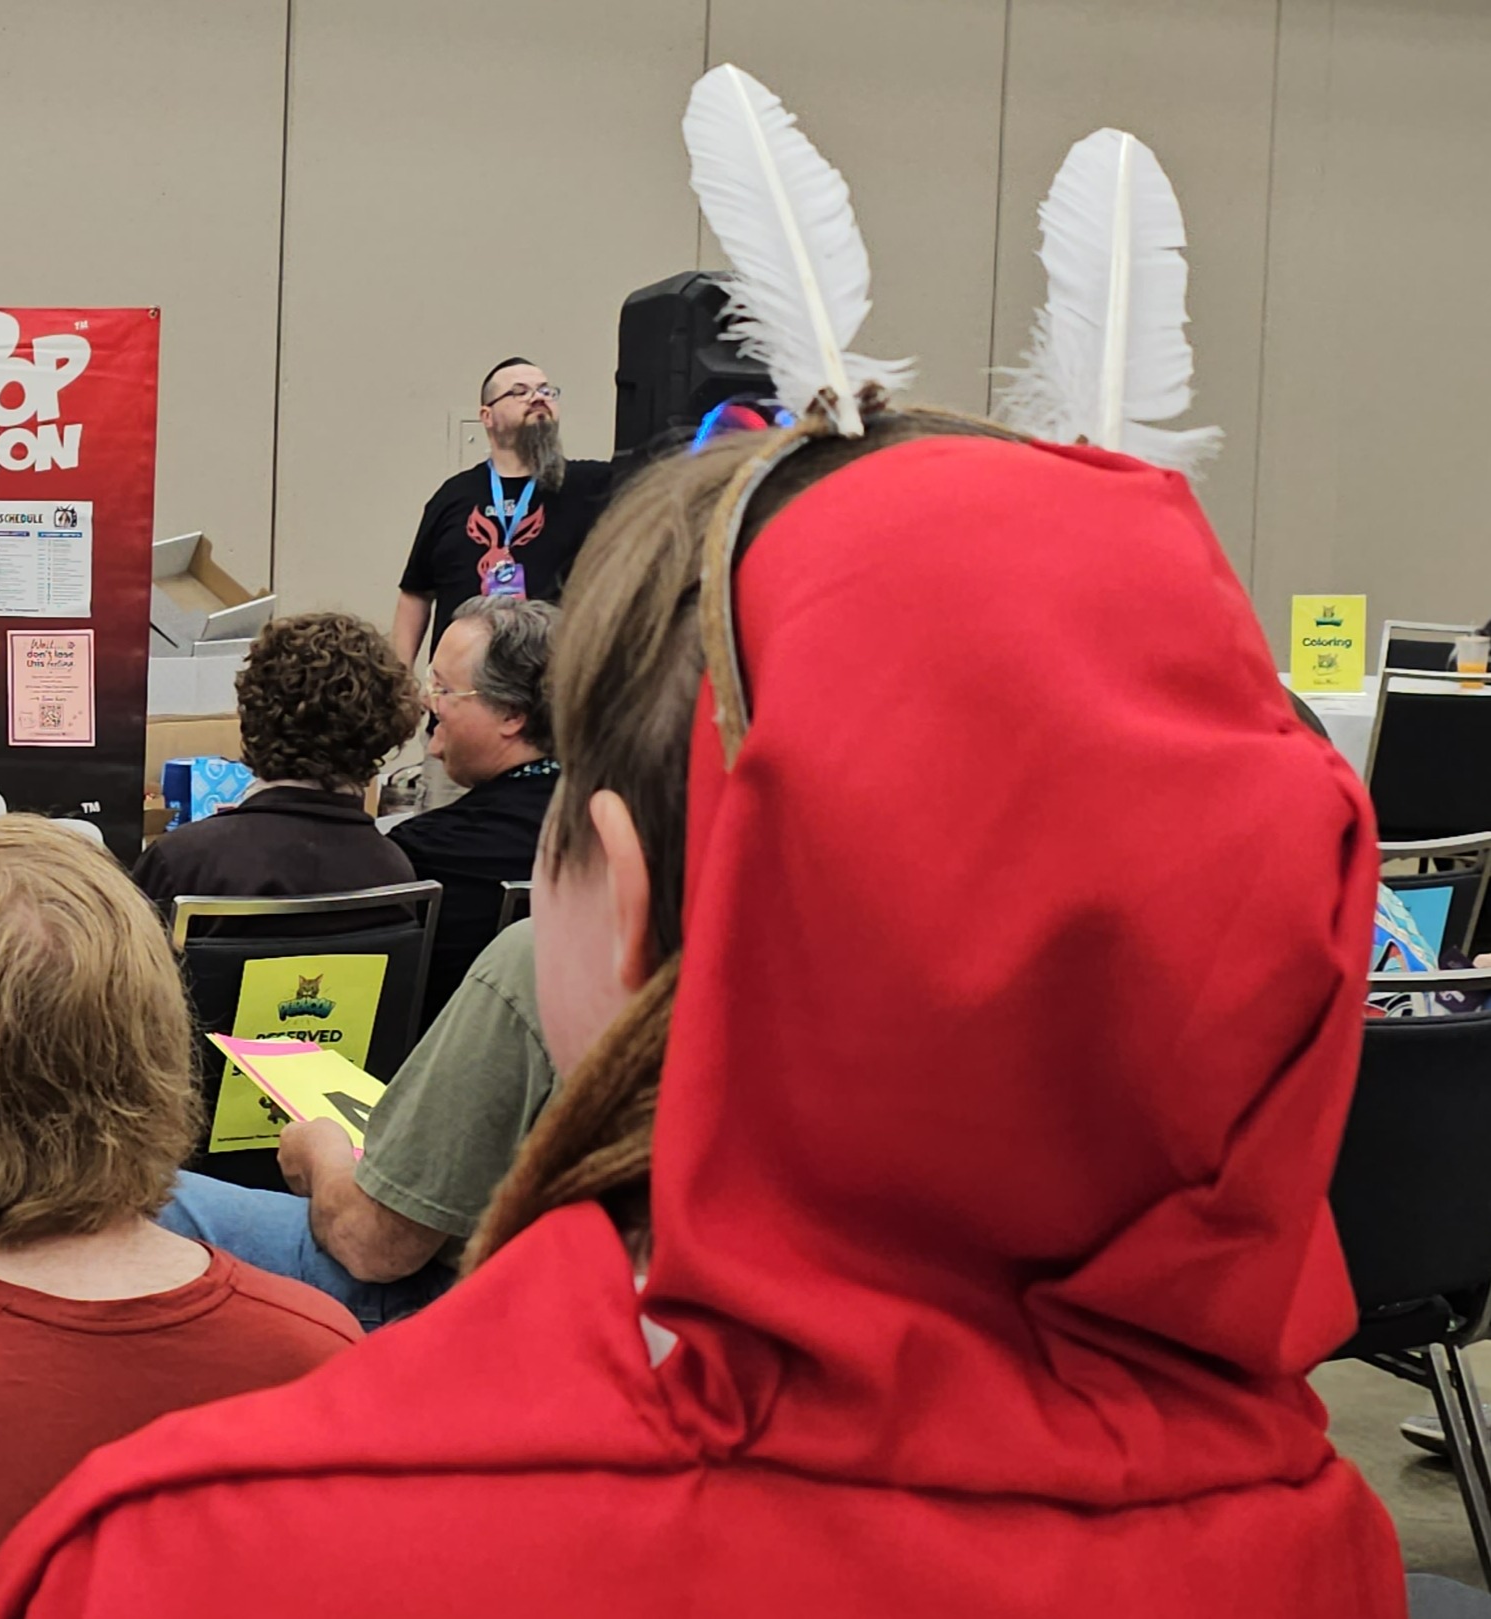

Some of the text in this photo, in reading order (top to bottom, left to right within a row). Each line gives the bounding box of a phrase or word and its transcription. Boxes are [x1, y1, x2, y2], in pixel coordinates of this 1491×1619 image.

[0, 513, 44, 524] SCHEDULE
[1302, 637, 1353, 649] Coloring
[81, 800, 101, 814] TM
